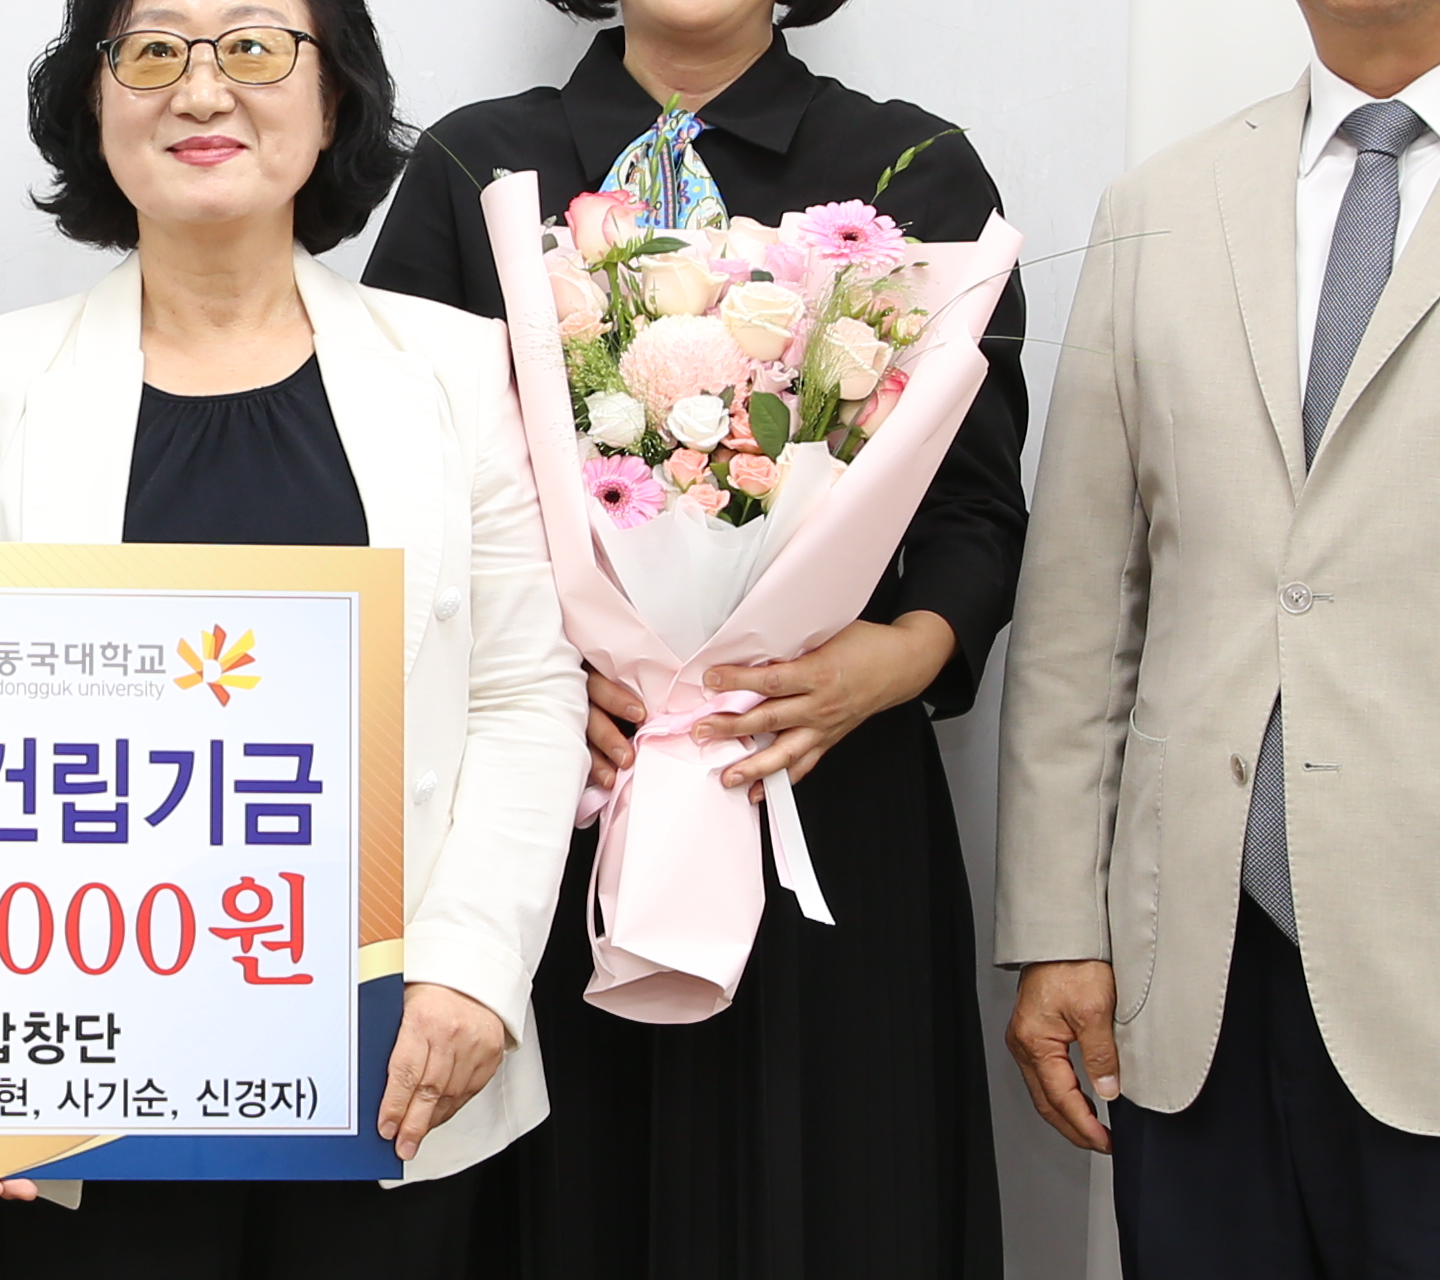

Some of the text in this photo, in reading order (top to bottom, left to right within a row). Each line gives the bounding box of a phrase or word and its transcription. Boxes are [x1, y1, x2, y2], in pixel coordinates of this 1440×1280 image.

[78, 680, 165, 701] university
[58, 1078, 178, 1120] 사기순,
[197, 1077, 317, 1120] 신경자)
